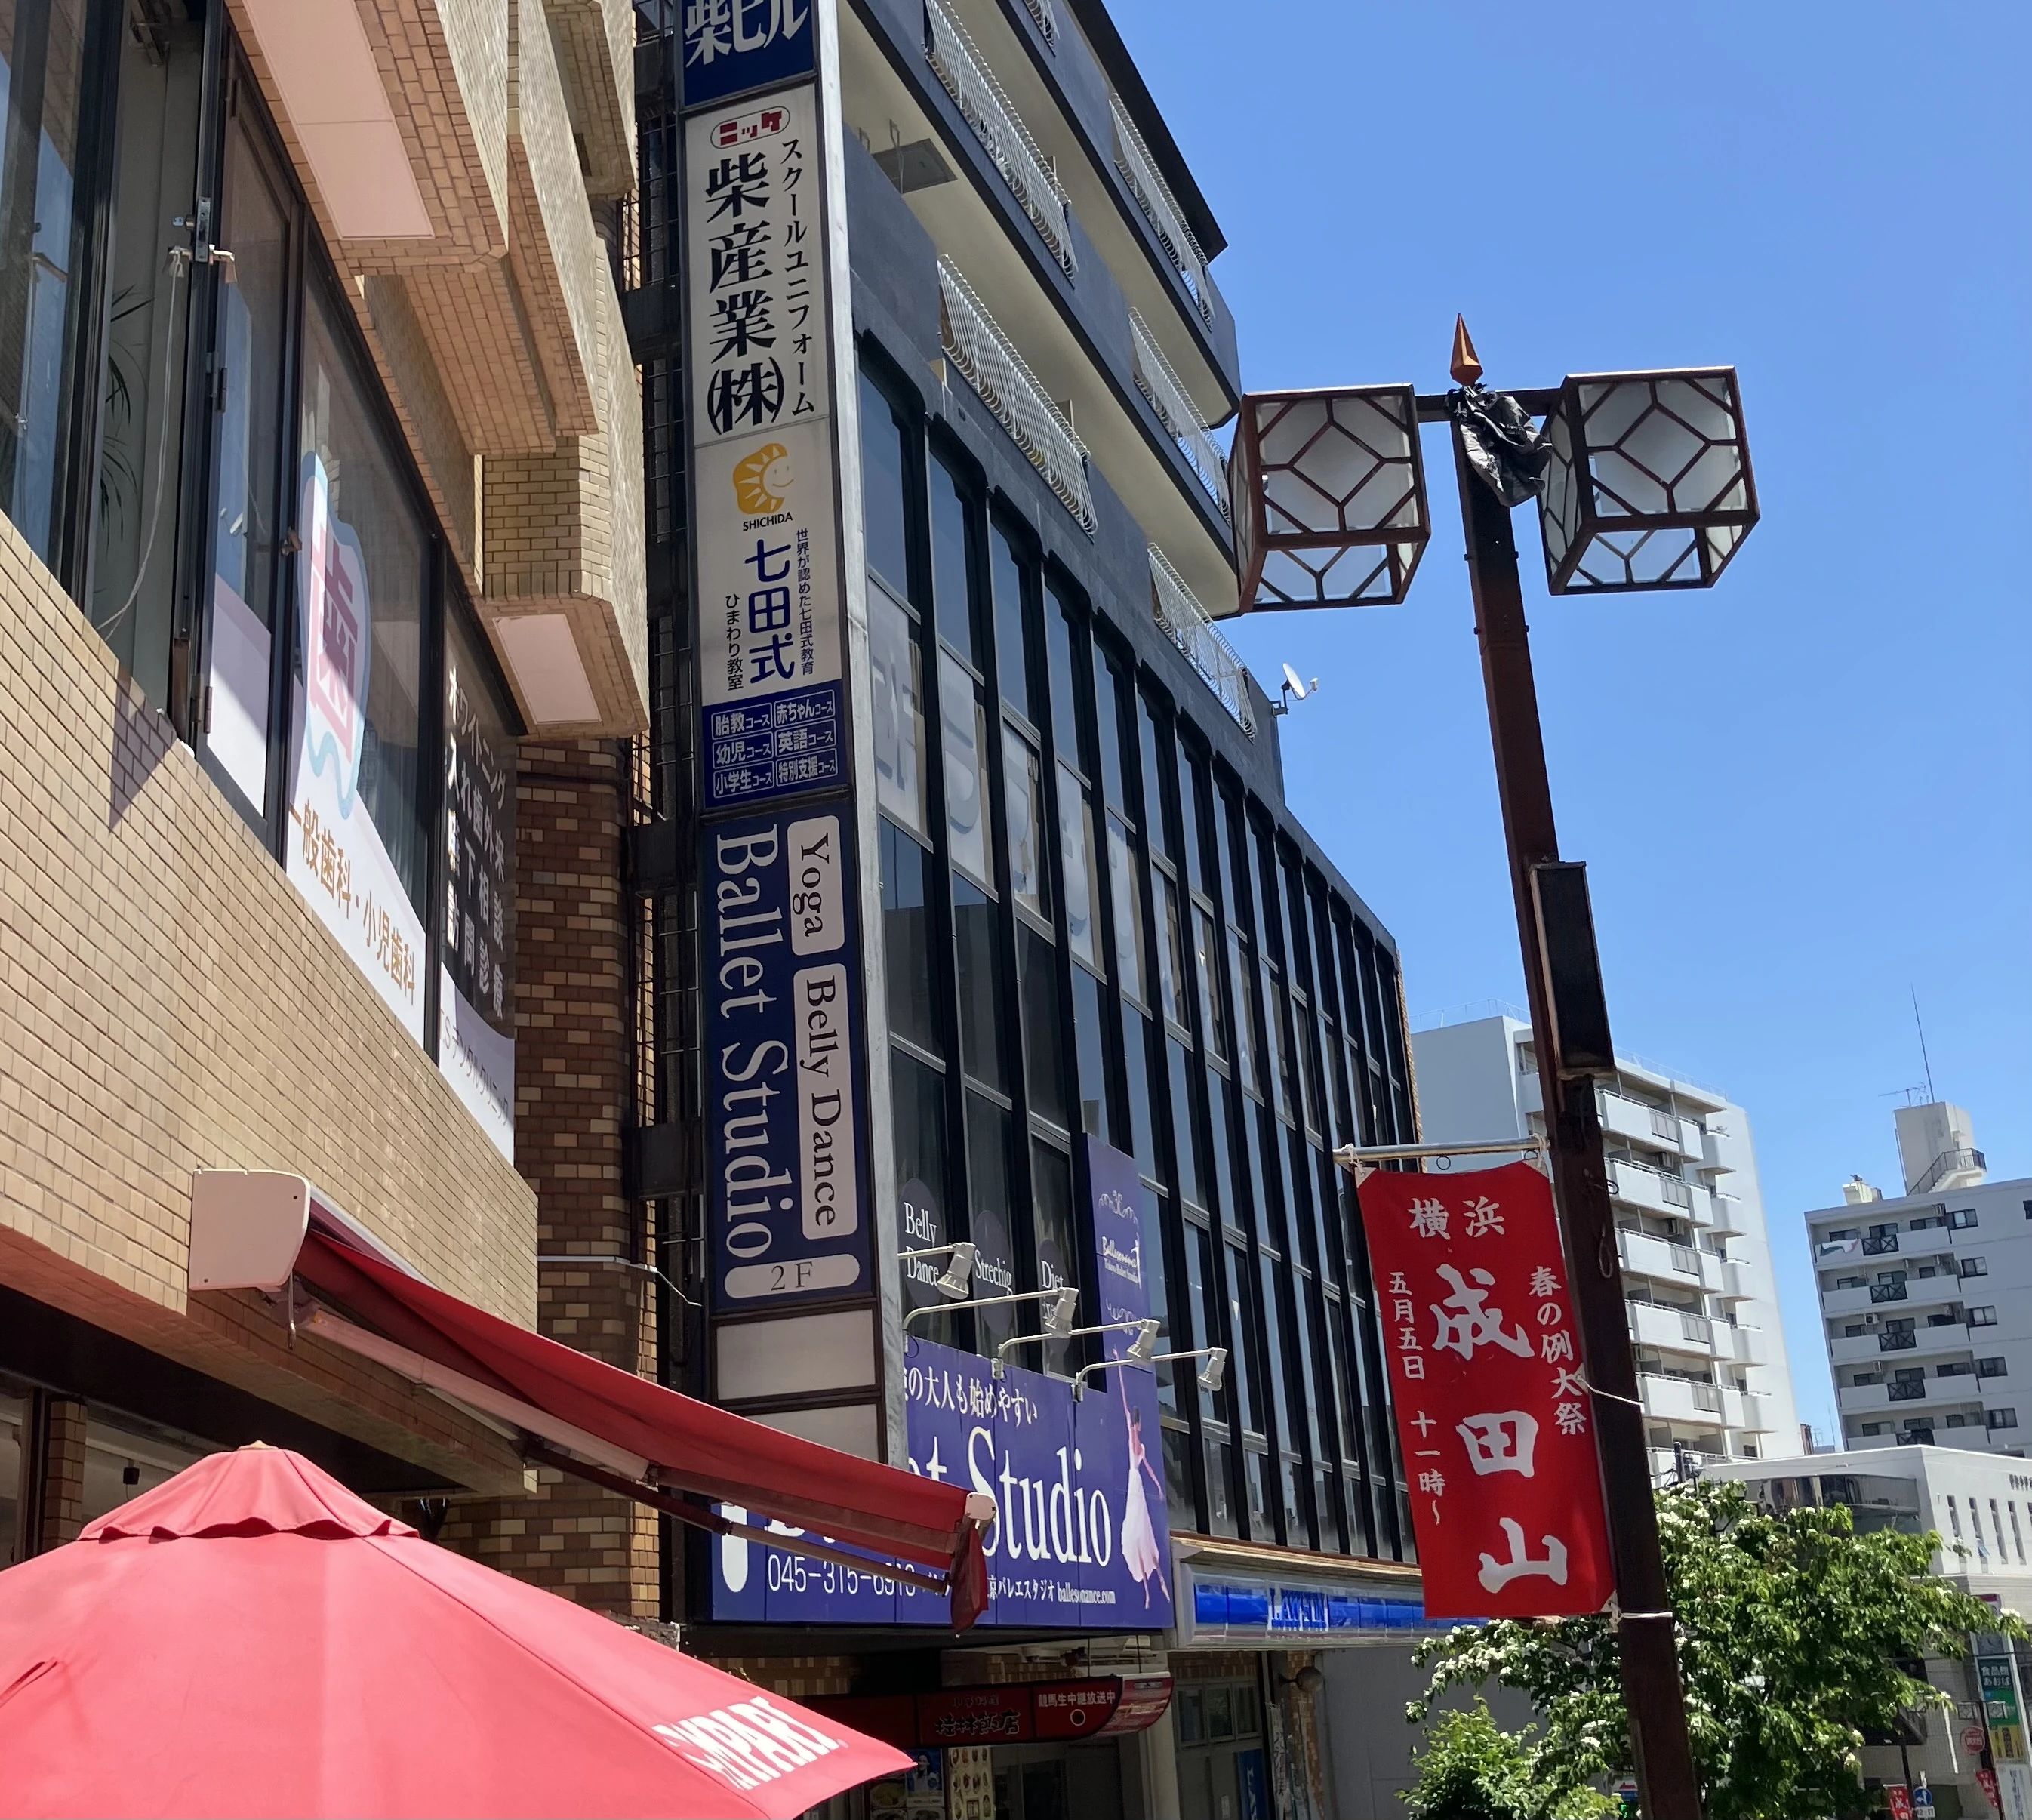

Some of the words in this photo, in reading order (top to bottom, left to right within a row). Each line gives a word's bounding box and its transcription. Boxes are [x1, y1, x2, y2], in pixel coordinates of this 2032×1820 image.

[719, 111, 783, 146] ニッケ
[780, 138, 815, 417] スクールユニフォーム
[742, 512, 794, 531] SHICHIDA
[725, 593, 744, 691] ひまわり教室
[744, 538, 795, 685] 七田式
[795, 528, 814, 676] 世界が認めた七田式教育
[448, 664, 506, 810] ホワイトニング
[715, 712, 771, 737] 胎教コース
[716, 741, 771, 765] 幼児コース
[777, 699, 833, 725] 赤ちゃんコース
[777, 728, 833, 753] 英語コース
[448, 732, 505, 883] 入れ歯外来
[716, 769, 773, 795] 小学生コース
[778, 755, 836, 784] 特別支援コース
[716, 824, 784, 1018] Ballet
[792, 832, 830, 938] Yoga
[799, 975, 836, 1079] Belly
[722, 1039, 794, 1258] Studio
[811, 1089, 842, 1227] Dance
[903, 1201, 937, 1245] Belly
[906, 1246, 940, 1287] Dance
[1409, 1196, 1505, 1240] 横浜
[1041, 1260, 1064, 1290] Diet
[1388, 1271, 1426, 1381] 五月五日
[1529, 1266, 1587, 1436] 春の例大祭
[904, 1366, 1038, 1427] の大人も始めやすい
[1430, 1262, 1569, 1595] 成田山
[968, 1426, 1113, 1568] Studio
